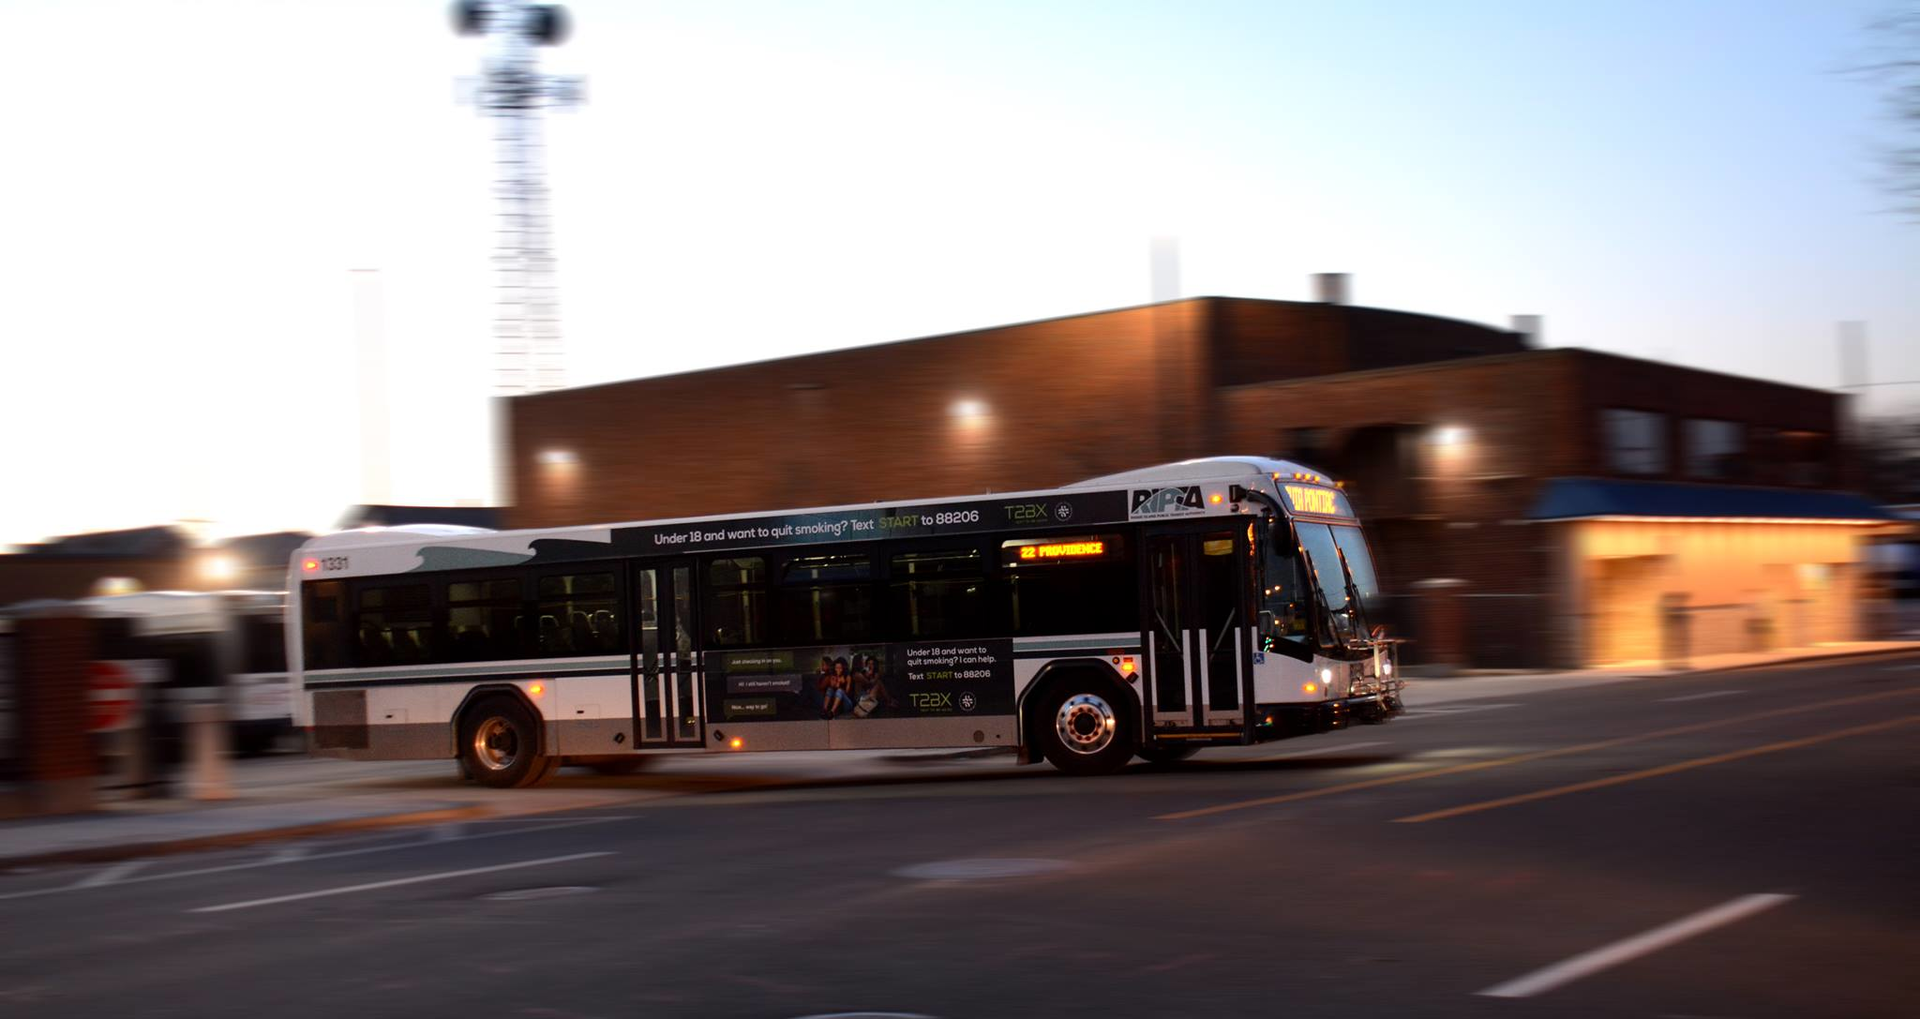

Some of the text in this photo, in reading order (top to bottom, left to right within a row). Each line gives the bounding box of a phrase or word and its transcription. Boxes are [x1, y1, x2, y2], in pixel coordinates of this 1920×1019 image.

[1131, 486, 1205, 513] RIPTA
[654, 510, 979, 545] Under 18 and want to quit smoking? Text START to 88206
[1020, 541, 1104, 559] 22 PROVIDENCE
[321, 556, 349, 571] 1331
[906, 646, 987, 657] Under 18 and want to
[906, 655, 997, 667] quit smoking? I can help.
[908, 669, 991, 681] Text START to 88206
